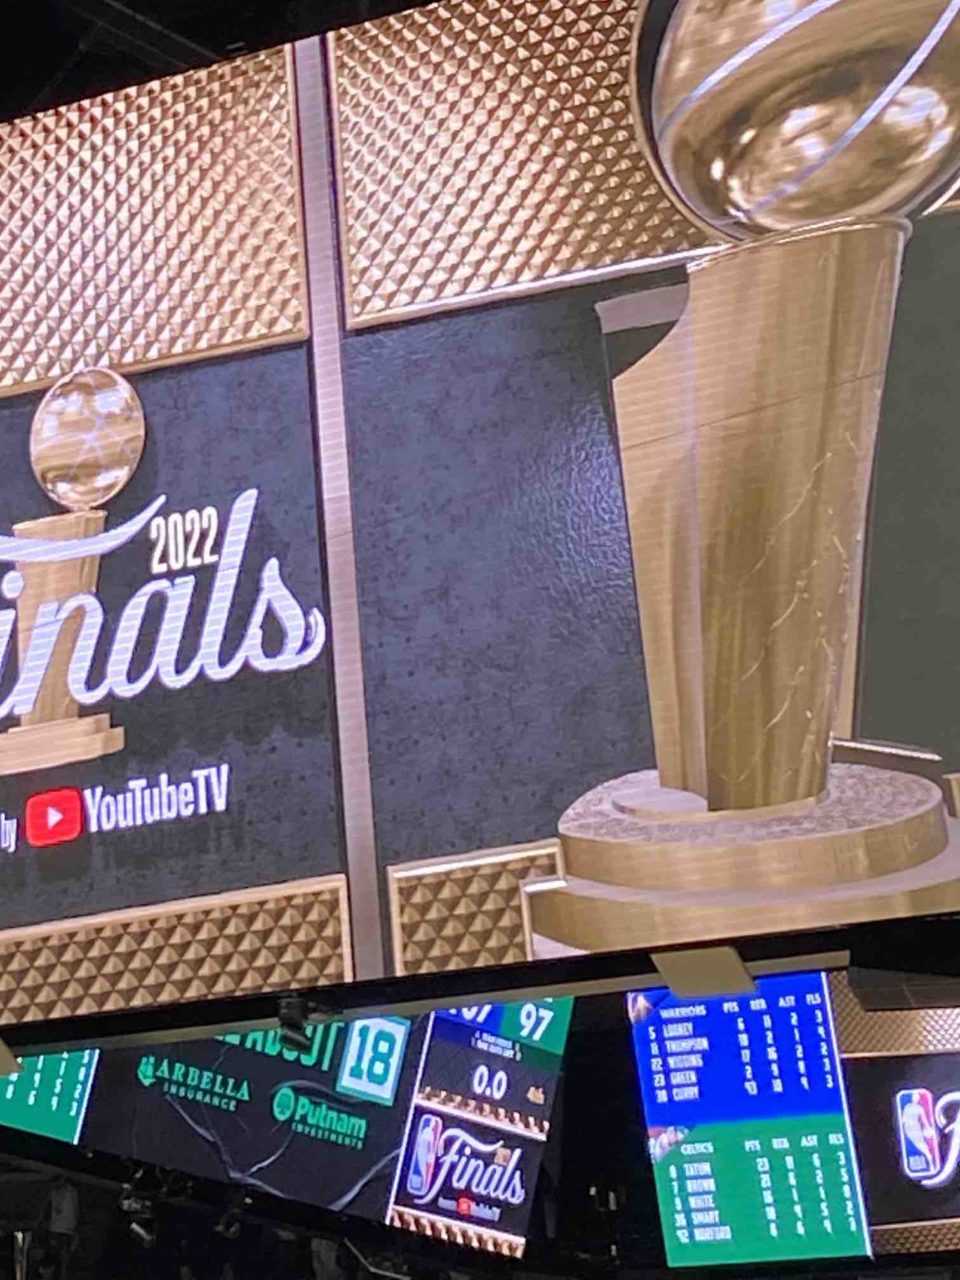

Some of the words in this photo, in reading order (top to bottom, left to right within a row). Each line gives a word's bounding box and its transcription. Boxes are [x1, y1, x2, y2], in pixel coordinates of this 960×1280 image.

[149, 506, 219, 573] 2022
[520, 1003, 554, 1040] 97
[349, 1023, 398, 1086] 18
[155, 1058, 250, 1101] ARBELLA
[163, 1082, 238, 1111] INSURANCE
[473, 1065, 508, 1099] 0.0
[295, 1096, 367, 1138] Putnam
[414, 1128, 525, 1204] Finals
